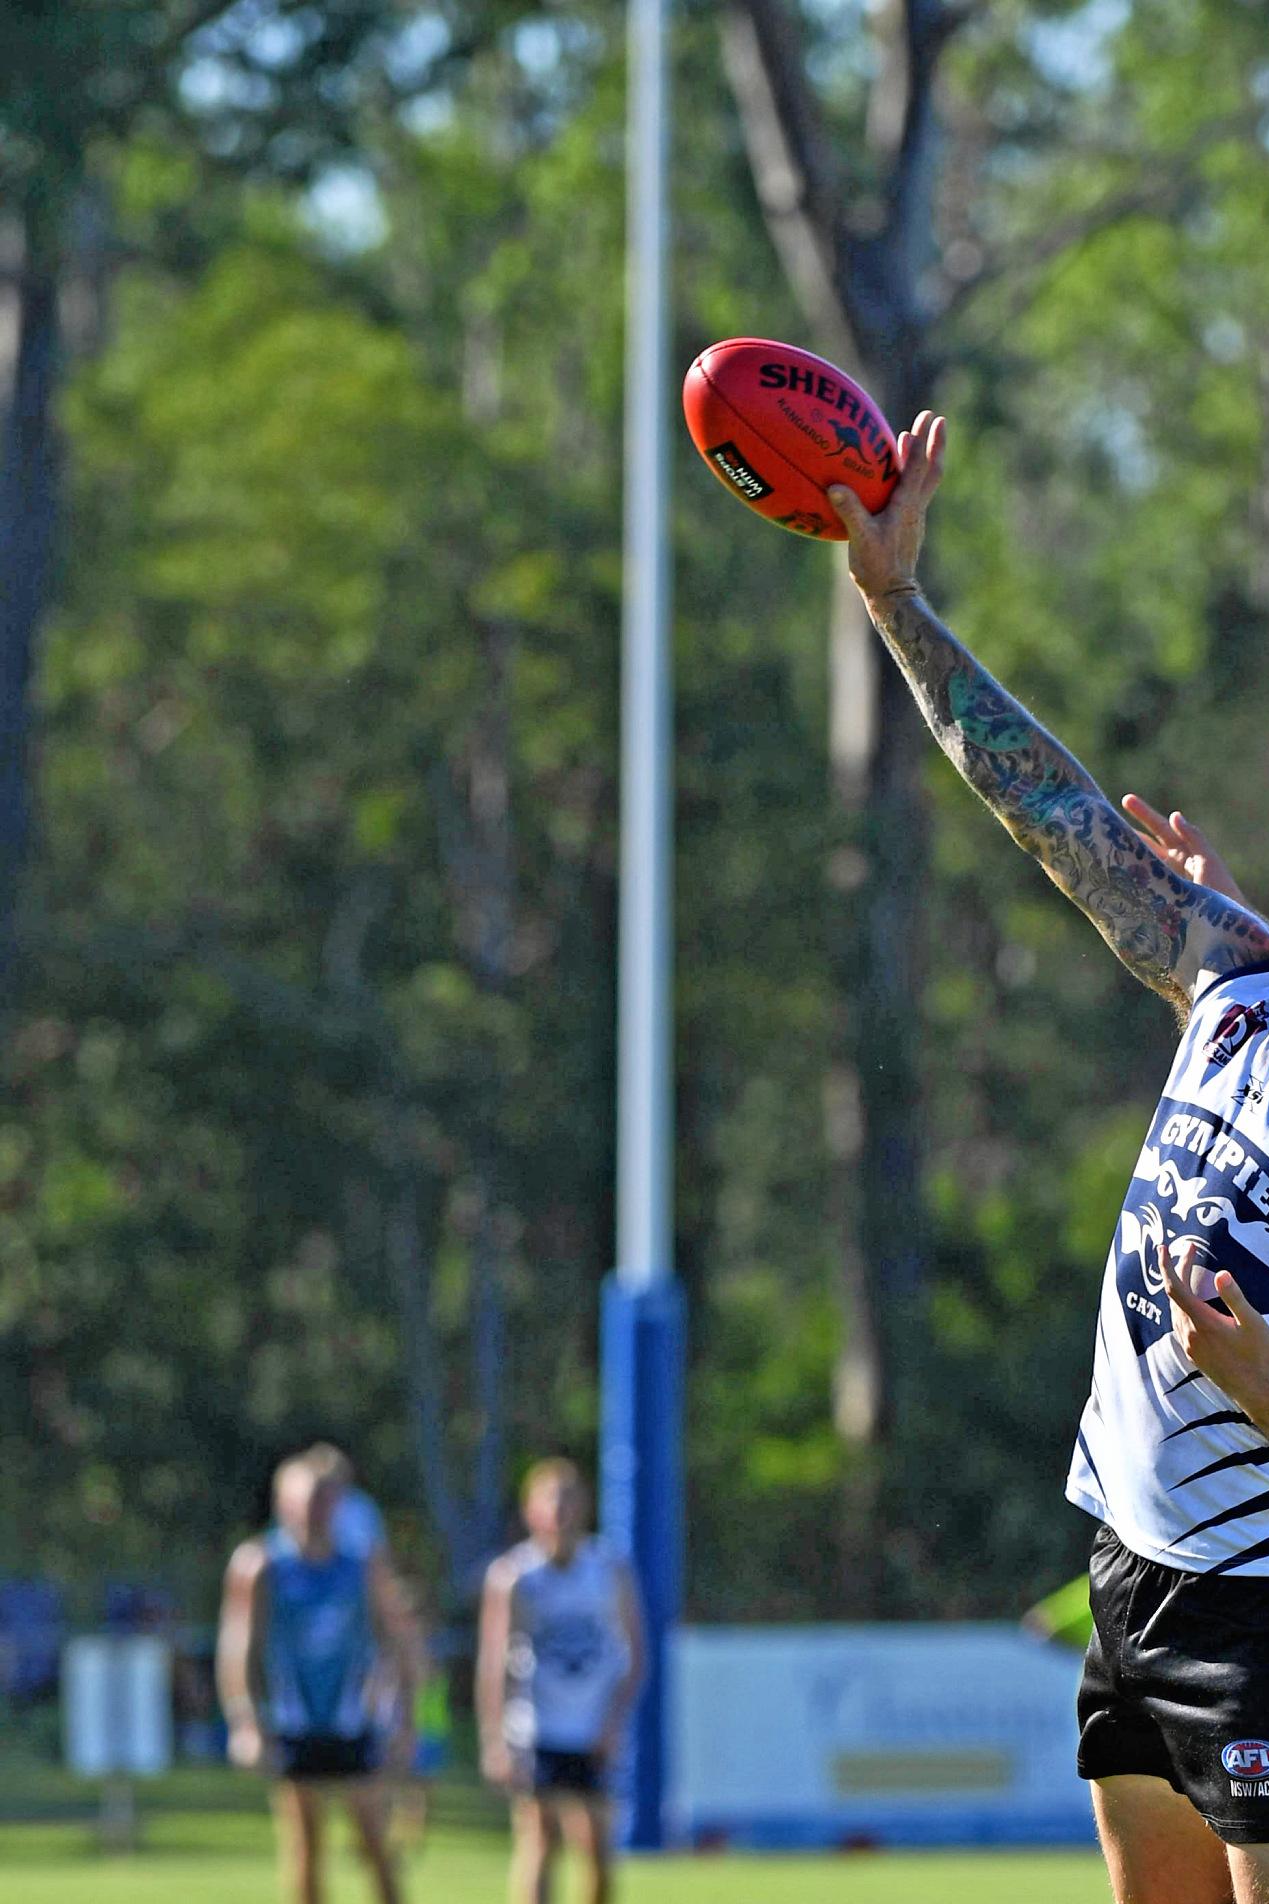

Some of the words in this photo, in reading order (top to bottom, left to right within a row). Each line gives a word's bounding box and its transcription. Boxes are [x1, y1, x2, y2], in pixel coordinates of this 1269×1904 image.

[760, 364, 897, 482] SHERRIN
[777, 398, 829, 450] KANGAROO
[735, 467, 763, 494] WITH
